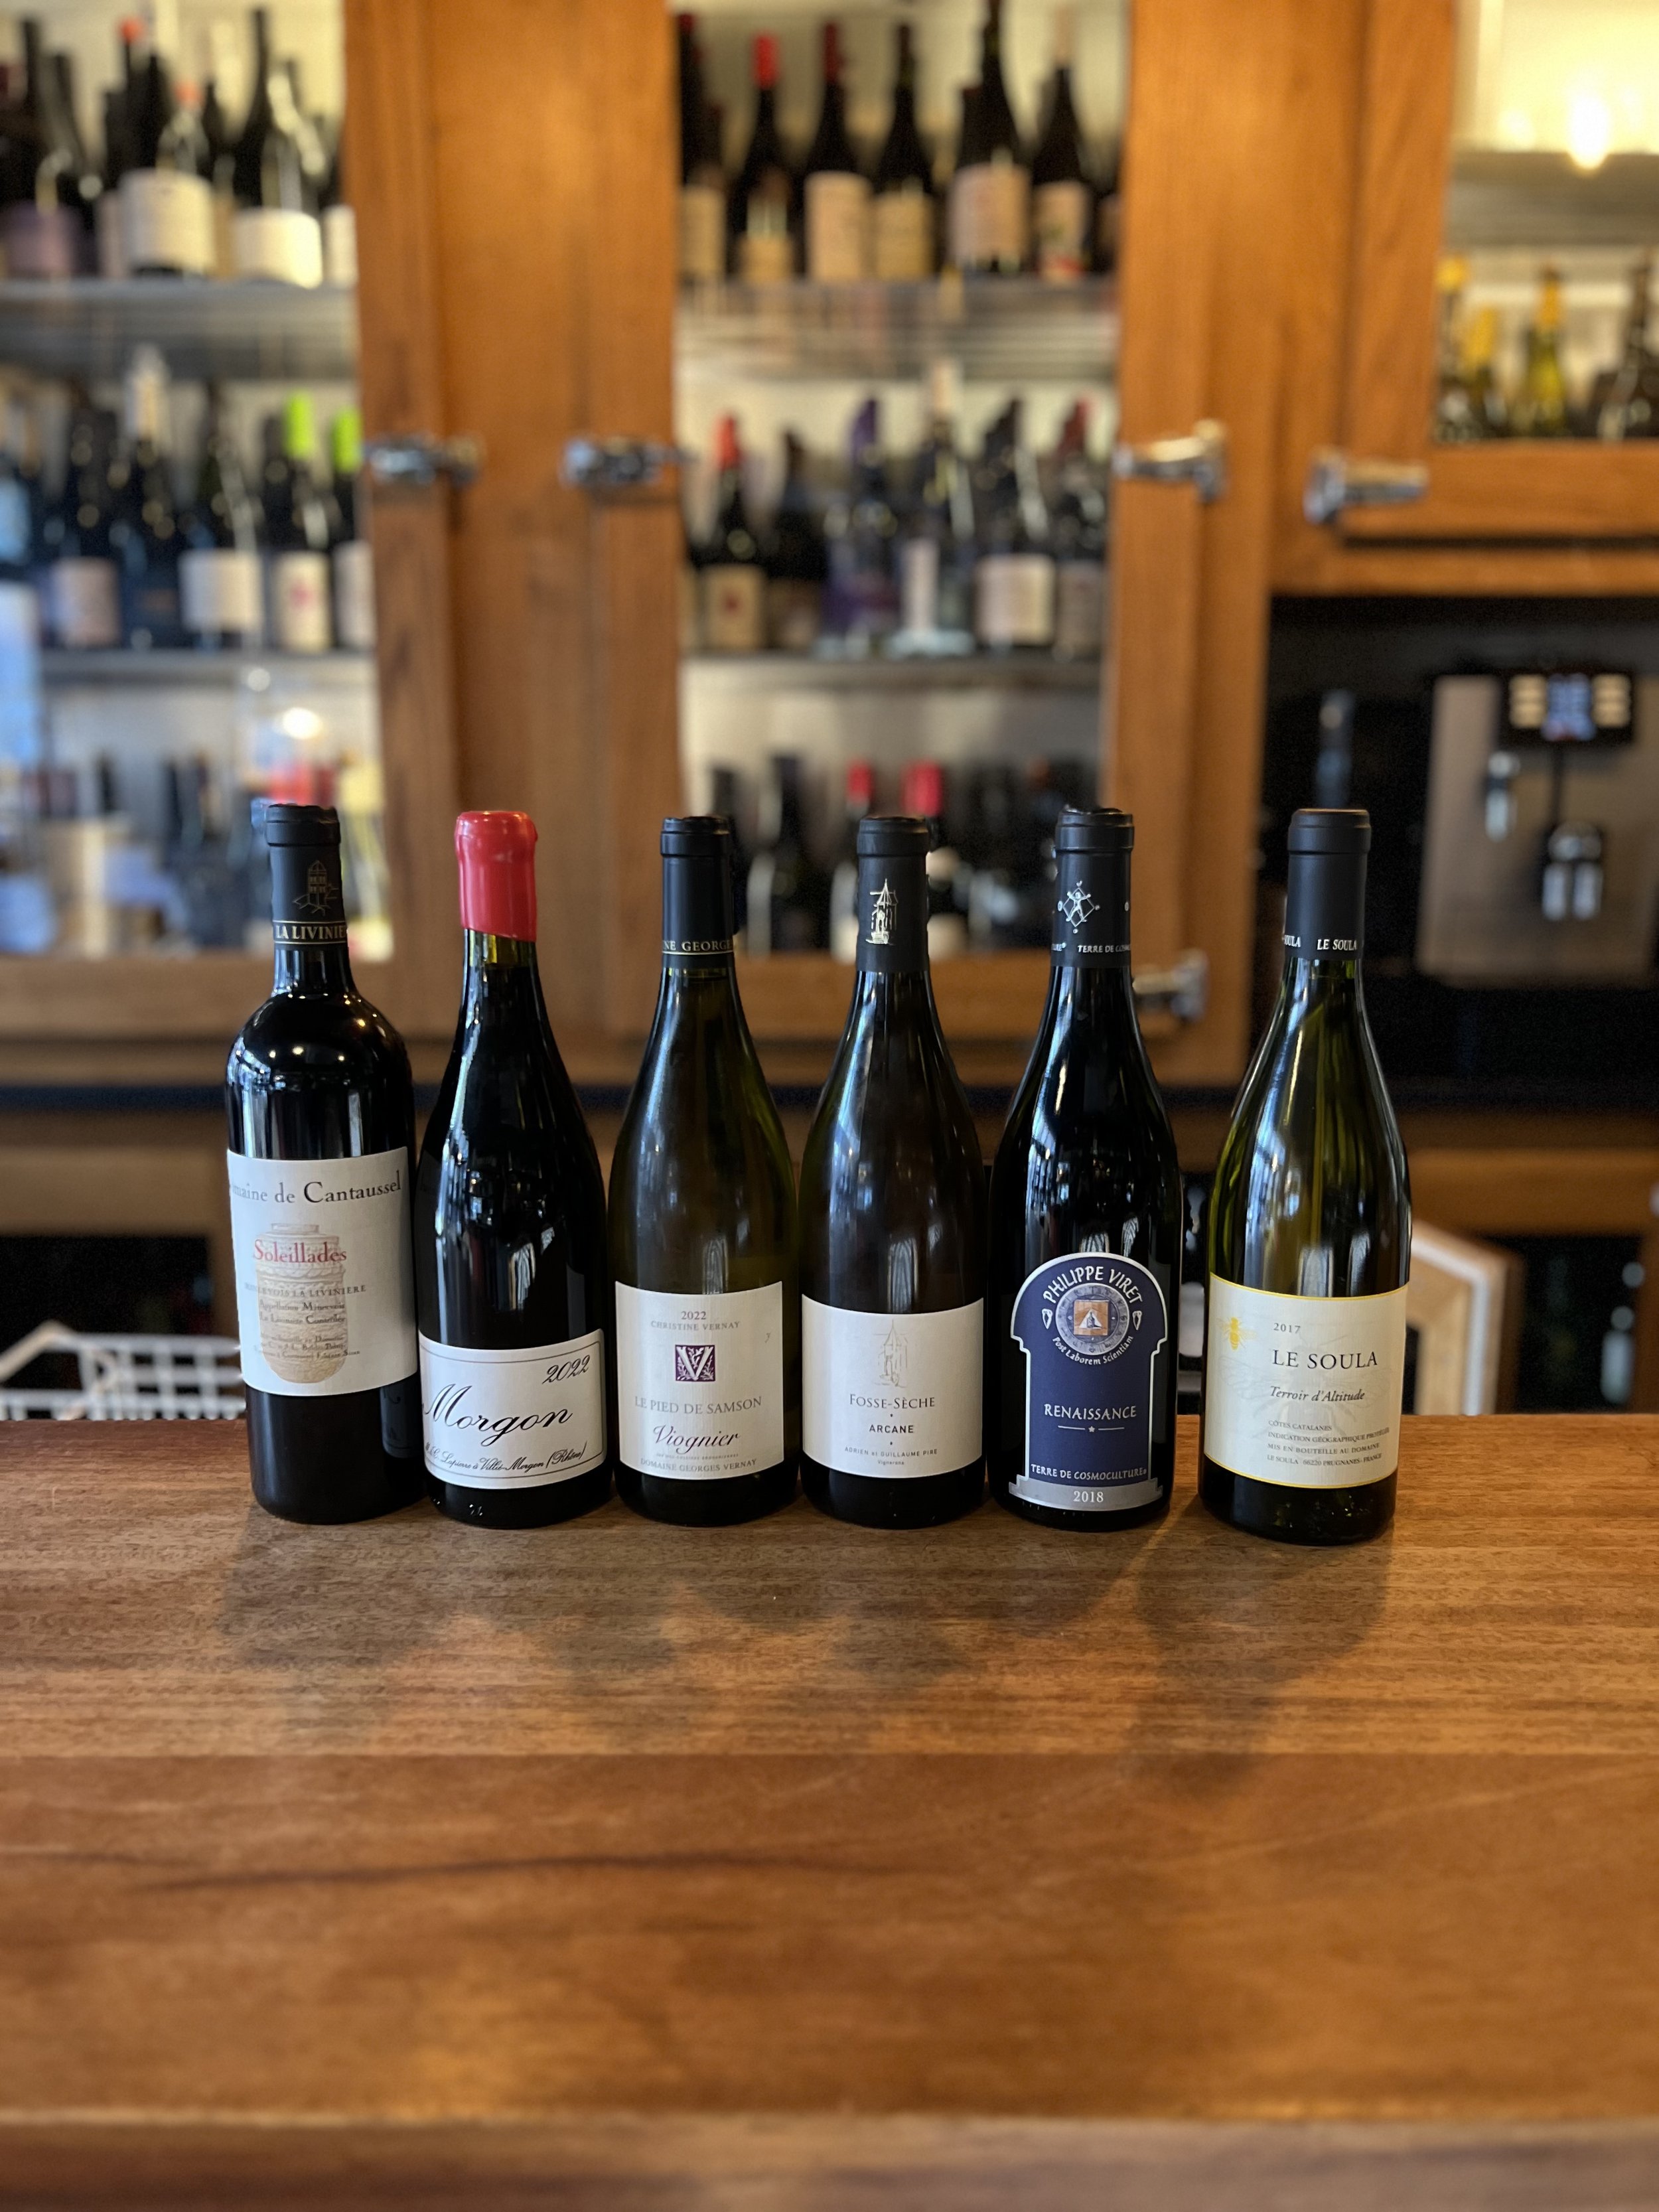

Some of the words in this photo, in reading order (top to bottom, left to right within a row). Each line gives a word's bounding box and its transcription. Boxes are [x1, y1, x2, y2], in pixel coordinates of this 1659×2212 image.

[275, 925, 289, 939] LA
[1078, 944, 1103, 953] TERRE
[1317, 939, 1330, 950] LE
[1333, 939, 1358, 951] SOULA
[274, 1181, 295, 1204] de
[304, 1170, 401, 1204] Cantaussel
[253, 1239, 347, 1263] Soleillades
[1043, 1266, 1104, 1303] PHILIPPE
[1109, 1269, 1143, 1303] VIRET
[681, 1311, 707, 1320] 2022
[650, 1320, 699, 1331] CHRISTINE
[703, 1321, 741, 1331] VERNAY
[1273, 1323, 1301, 1334] 2017
[1052, 1337, 1066, 1353] Post
[1065, 1349, 1102, 1365] Laborem
[1103, 1335, 1134, 1364] Scientiam
[1272, 1349, 1299, 1368] LE
[1307, 1351, 1378, 1370] SOULA
[541, 1355, 591, 1384] 2022
[1270, 1386, 1309, 1401] Terroir
[1311, 1388, 1365, 1402] d'Altitude
[635, 1396, 648, 1408] LE
[650, 1400, 679, 1414] PIED
[684, 1404, 703, 1414] DE
[707, 1396, 762, 1414] SAMSON
[1044, 1404, 1137, 1420] RENAISSANCE
[423, 1383, 573, 1447] Morgon
[869, 1424, 914, 1434] ARCANE
[653, 1424, 741, 1455] Viognier
[1268, 1432, 1311, 1442] INDICATION
[844, 1447, 869, 1455] ADRIEN
[1351, 1443, 1380, 1453] DOMAINE
[641, 1457, 676, 1471] DOMAINE
[723, 1458, 757, 1470] VERNAY
[1275, 1455, 1299, 1465] SOULA
[1031, 1463, 1057, 1477] TERRE
[1060, 1470, 1072, 1479] DE
[1073, 1491, 1104, 1503] 2018
